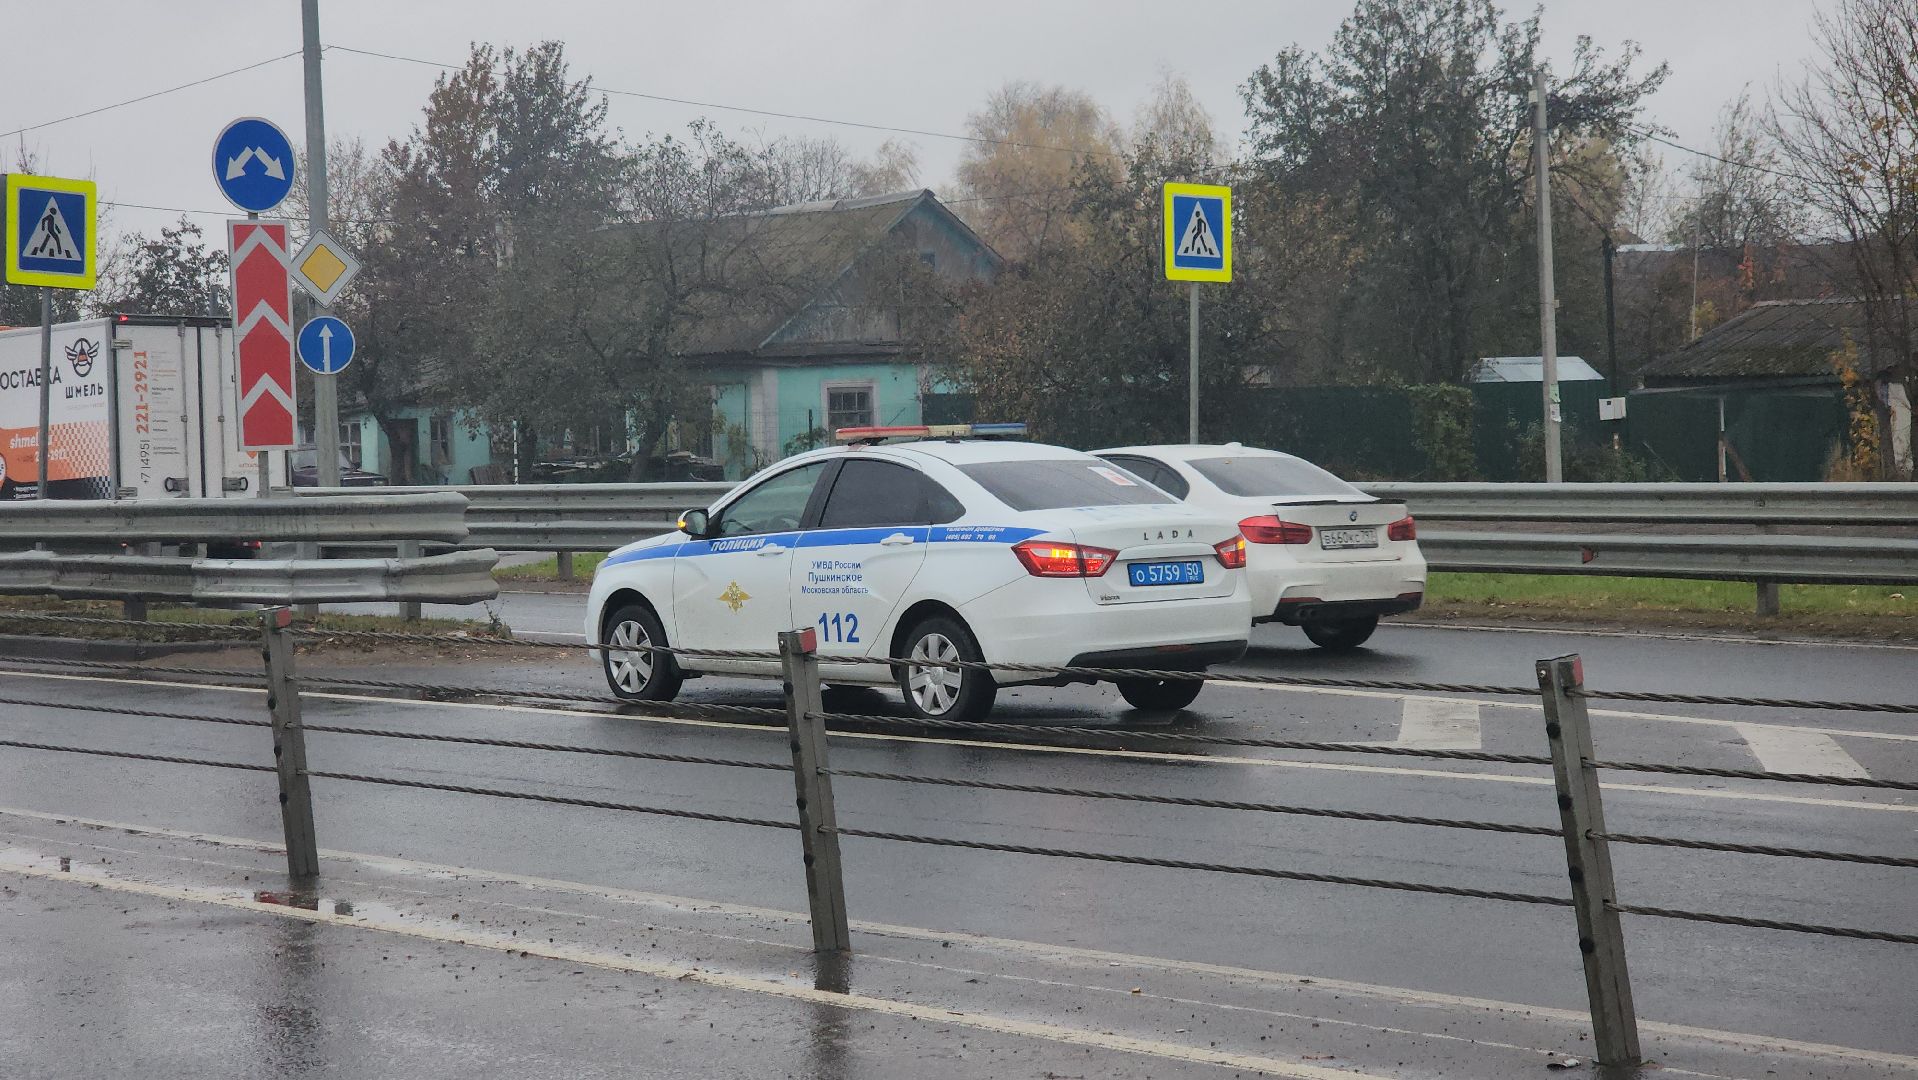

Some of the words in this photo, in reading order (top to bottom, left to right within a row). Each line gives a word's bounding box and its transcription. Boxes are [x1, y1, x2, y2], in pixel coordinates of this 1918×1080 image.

[65, 382, 104, 399] ШМЕЛЬ
[133, 350, 149, 434] 221-2921
[1143, 529, 1194, 541] LADA
[710, 538, 766, 551] ПОЛИЦИЯ
[811, 560, 833, 570] УМВД
[834, 560, 861, 570] России
[808, 571, 863, 584] Пушкинское
[1148, 564, 1180, 581] 5759
[1186, 563, 1199, 576] 50
[801, 585, 840, 594] Московская
[841, 585, 869, 594] область
[818, 612, 860, 643] 112
